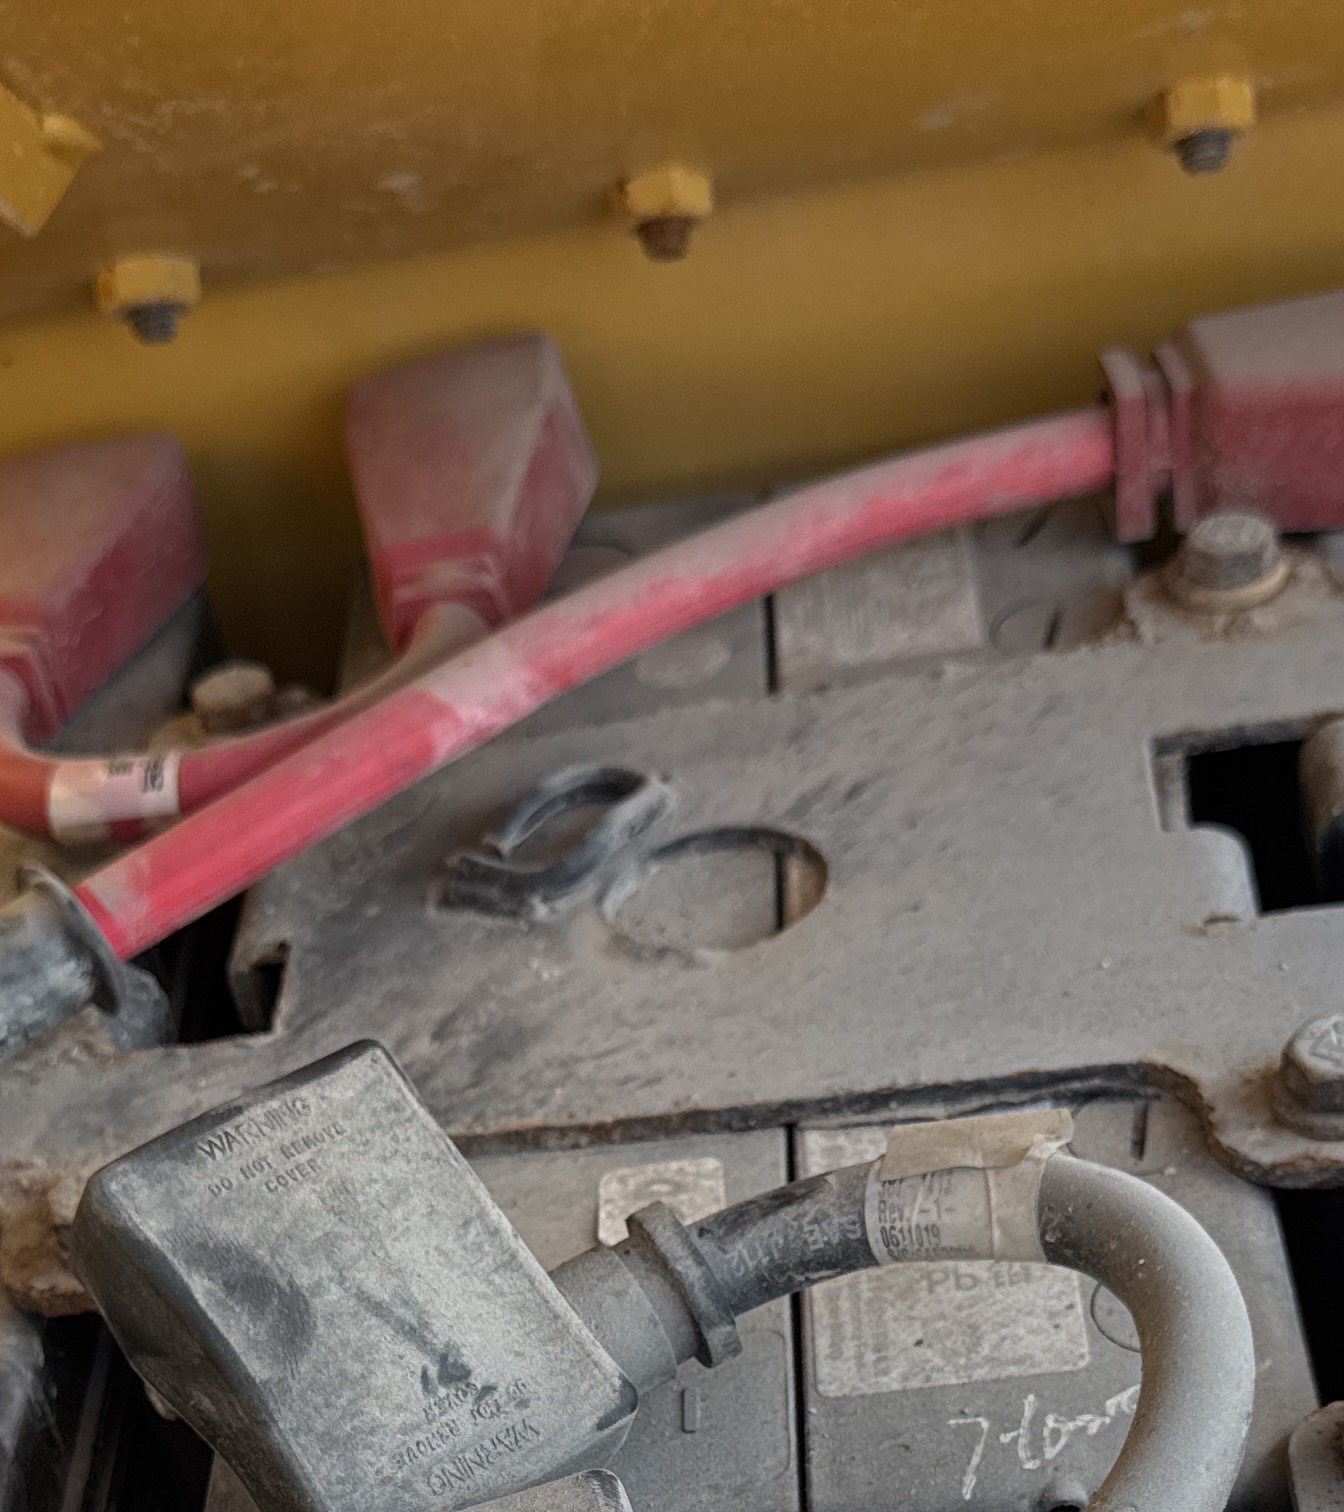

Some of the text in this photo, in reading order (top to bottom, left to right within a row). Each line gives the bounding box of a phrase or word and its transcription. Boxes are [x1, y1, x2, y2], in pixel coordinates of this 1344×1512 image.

[197, 1097, 311, 1161] WARNING
[207, 1121, 348, 1199] DO NOT REMOVE
[264, 1157, 323, 1194] COVER
[422, 1381, 480, 1423] COVER
[470, 1398, 506, 1427] NOT
[395, 1418, 462, 1470] REMOVE
[427, 1418, 541, 1497] WARNING
